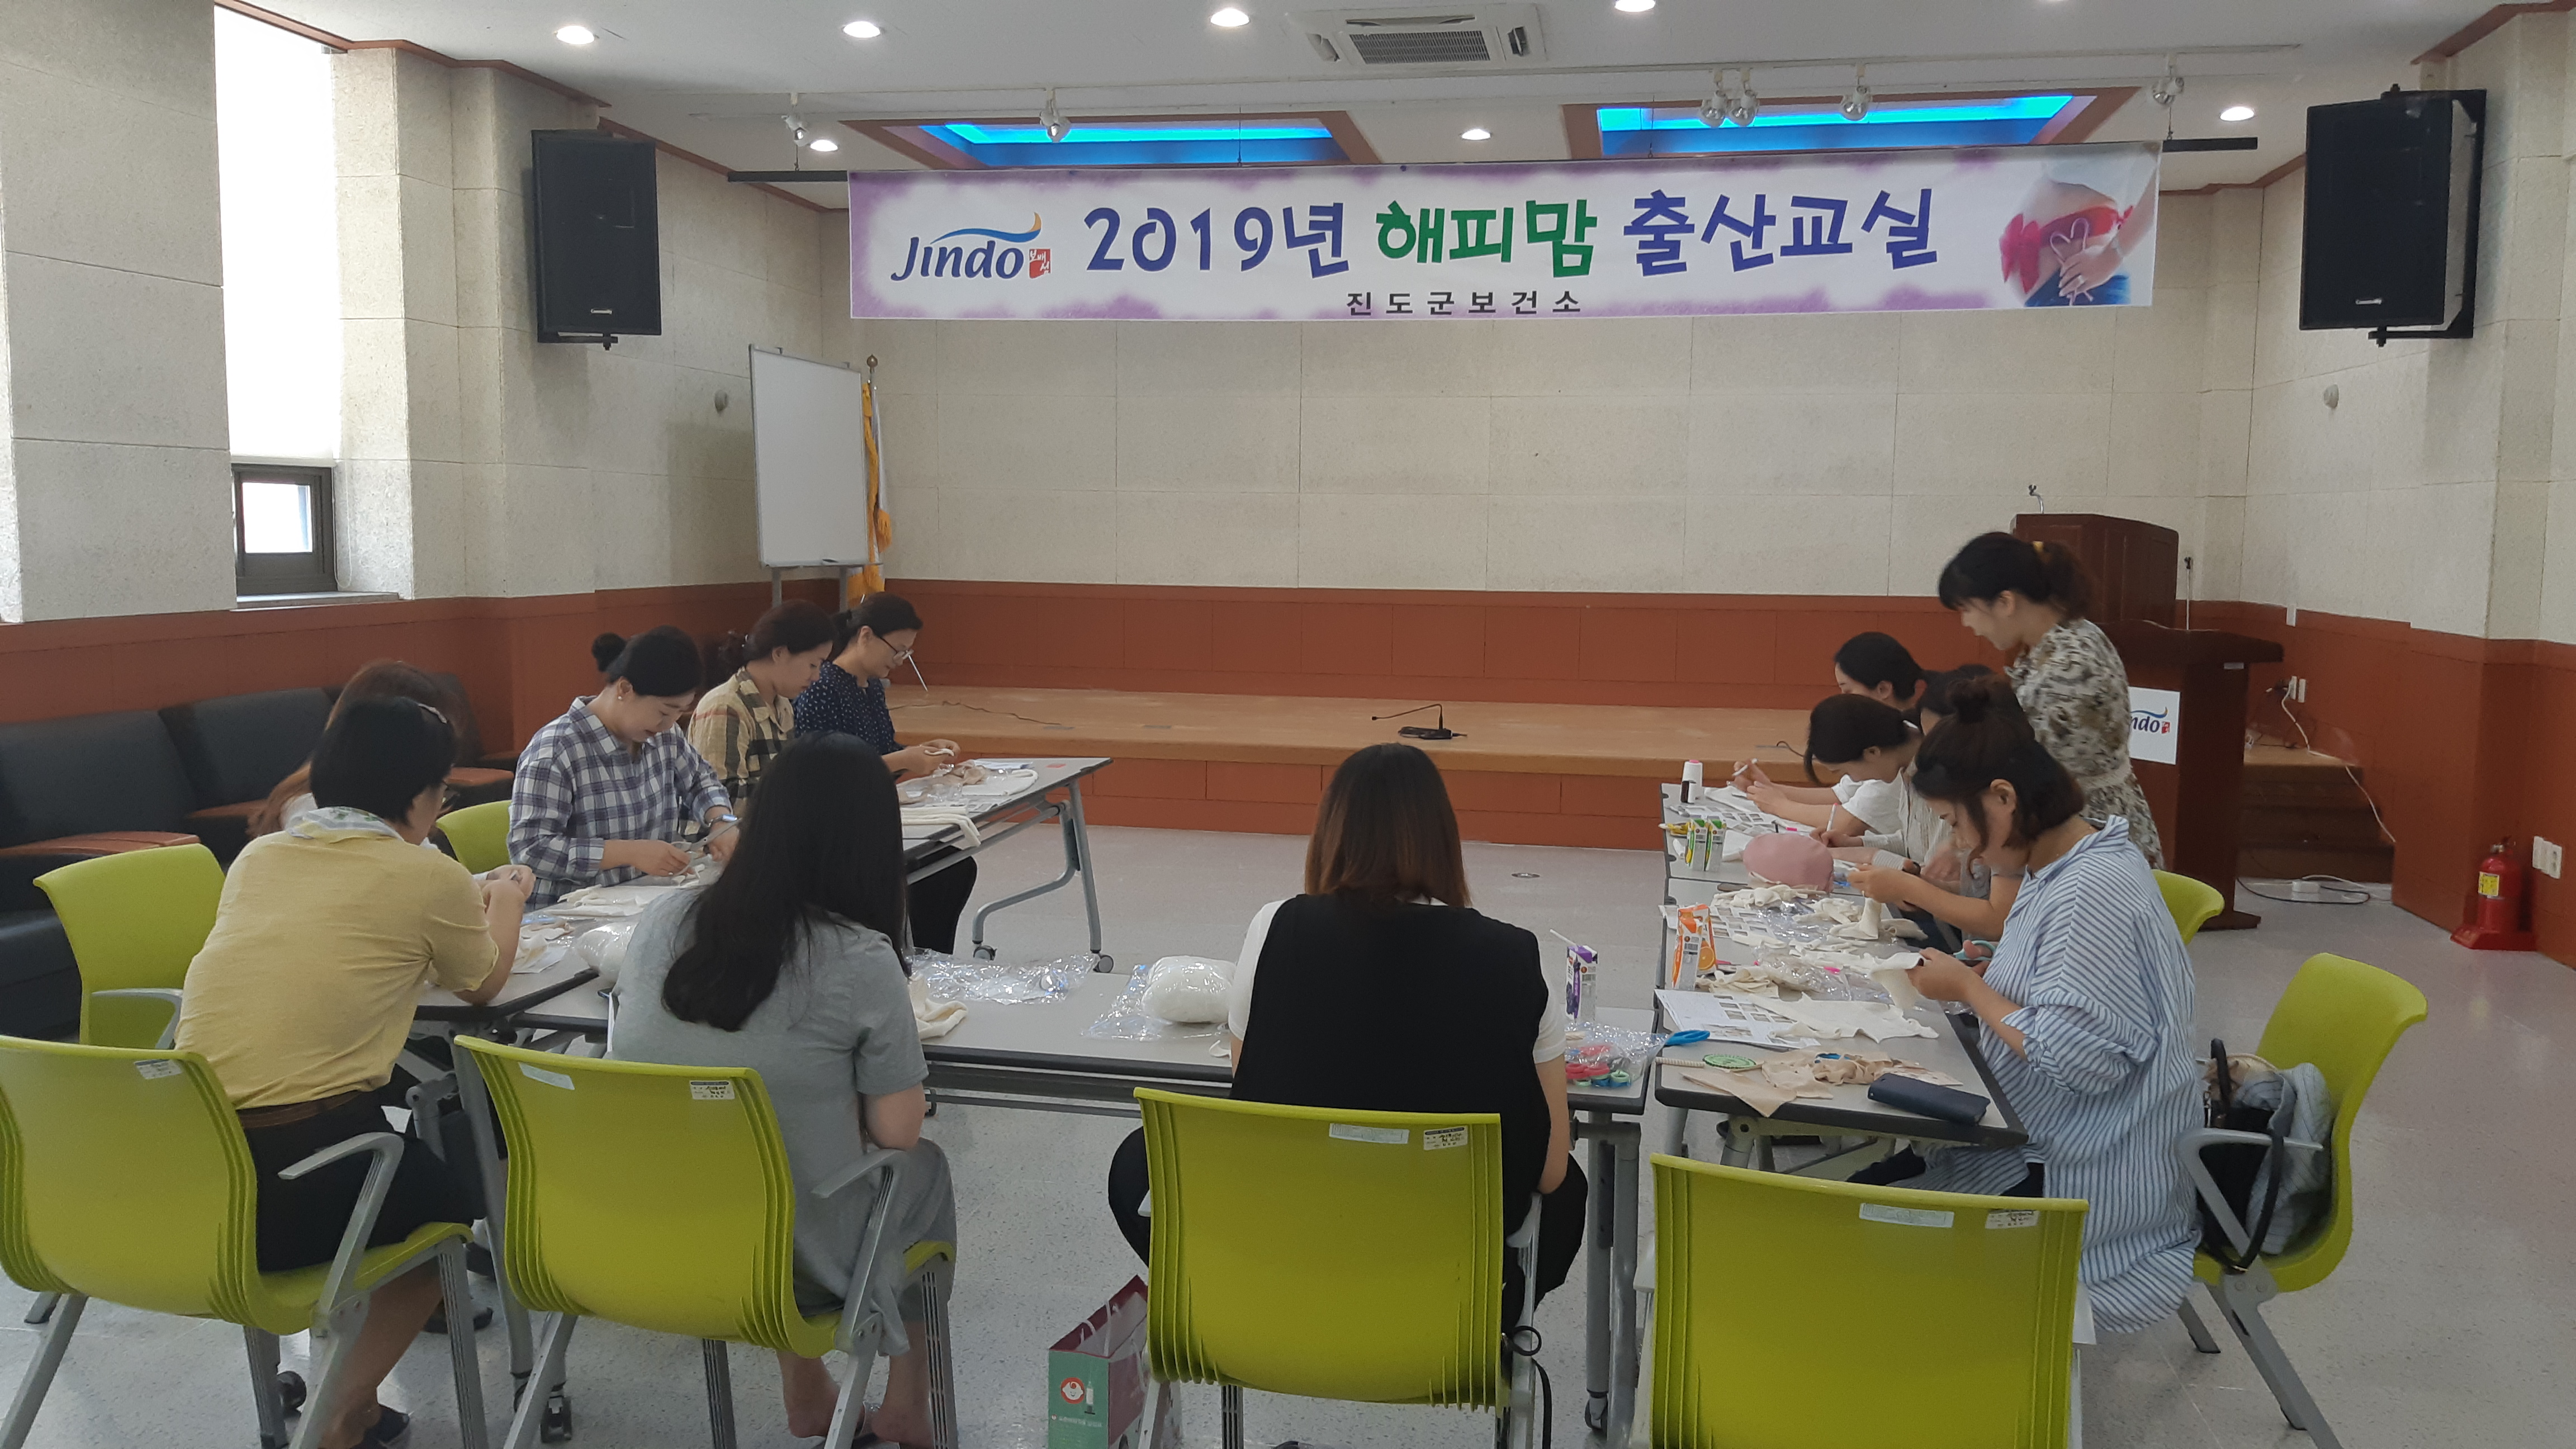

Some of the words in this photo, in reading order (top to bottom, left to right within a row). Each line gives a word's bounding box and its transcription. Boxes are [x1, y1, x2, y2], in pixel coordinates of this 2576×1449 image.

[1083, 202, 1349, 278] 2019년
[1375, 199, 1598, 278] 해피맘
[1623, 188, 1938, 277] 출산교실
[890, 236, 1025, 281] Jindo
[1346, 290, 1581, 316] 진도군보건소
[2130, 716, 2160, 733] ndo
